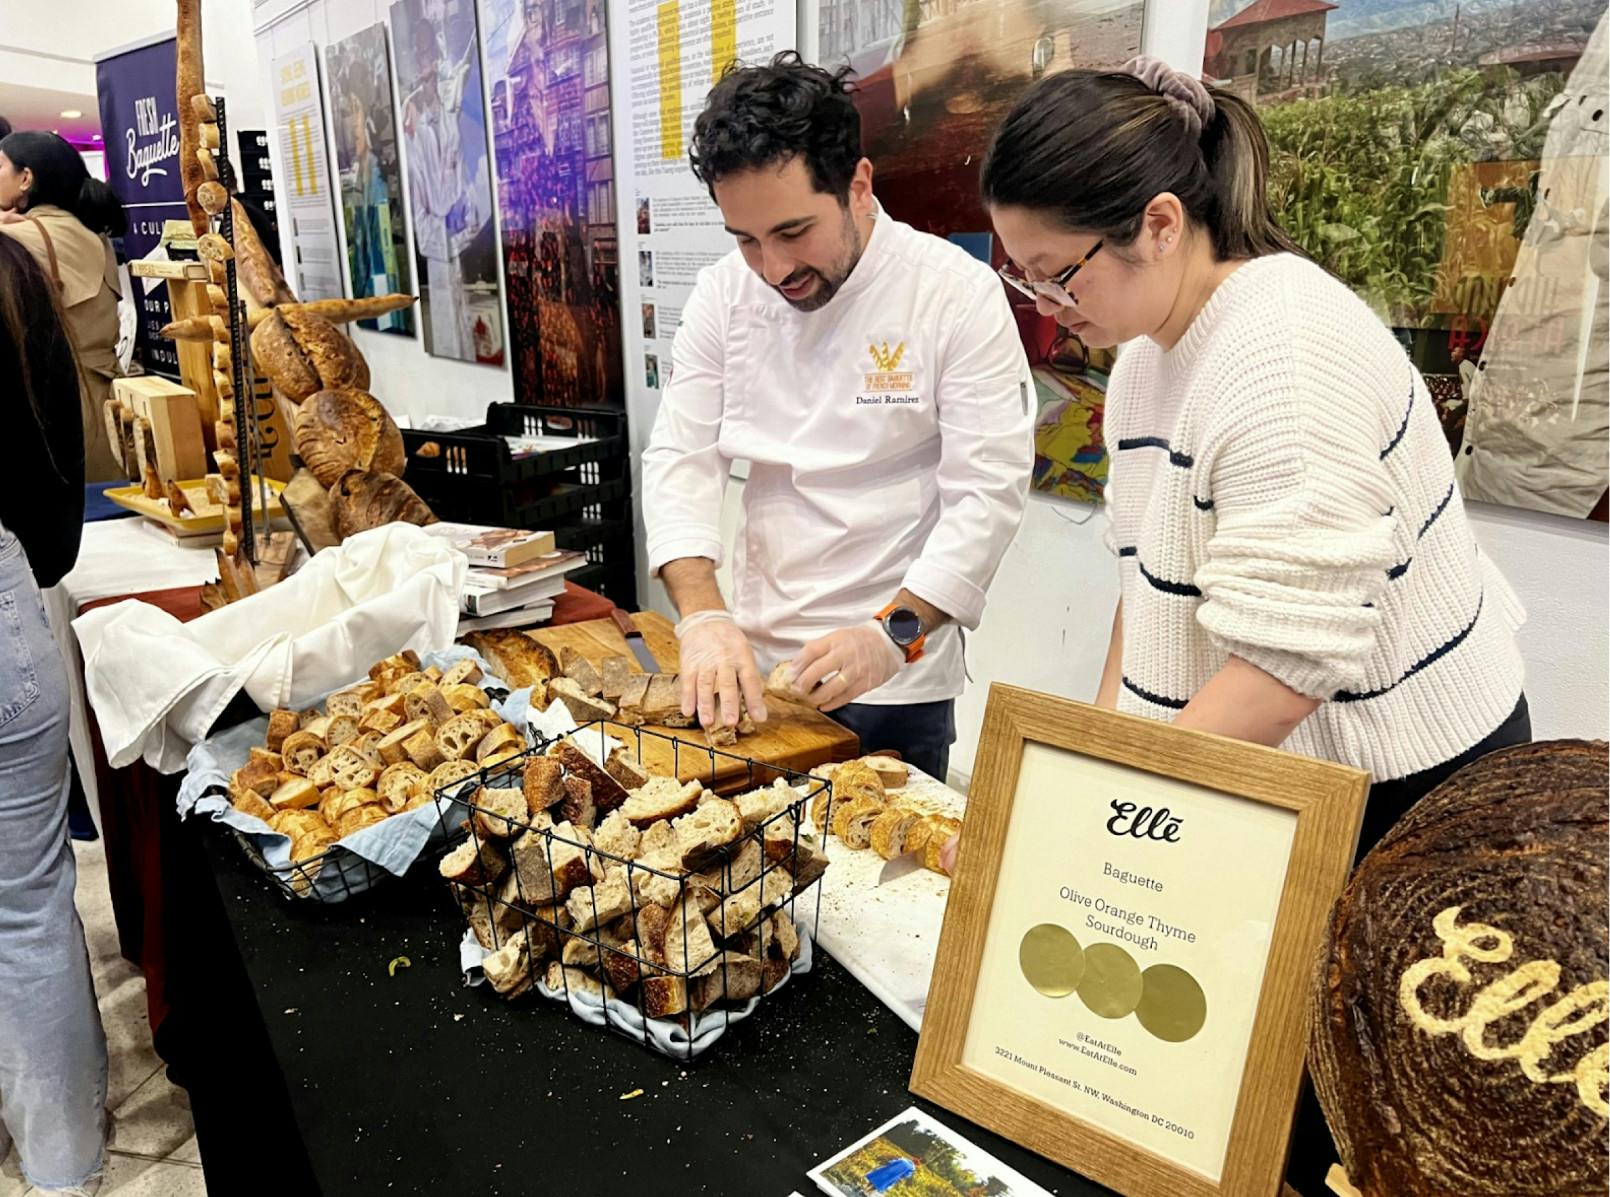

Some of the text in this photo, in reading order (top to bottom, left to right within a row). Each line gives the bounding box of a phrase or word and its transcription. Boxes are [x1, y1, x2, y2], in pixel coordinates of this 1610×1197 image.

[134, 96, 160, 137] FRESH
[126, 112, 179, 187] Baguette
[856, 396, 882, 404] Daniel
[1103, 861, 1164, 893] Baguette
[1059, 886, 1197, 943] Olive Orange Thyme
[1085, 914, 1159, 951] Sourdough
[1058, 1038, 1138, 1077] www.EatAtElle.com
[1076, 1031, 1123, 1057] @EatAtElle
[994, 1046, 1013, 1061] 3221
[1013, 1055, 1038, 1072] Mount
[1039, 1065, 1072, 1087] Pleasant
[1101, 1092, 1150, 1121] Washington
[1151, 1114, 1165, 1127] DC
[1165, 1120, 1195, 1140] 20010
